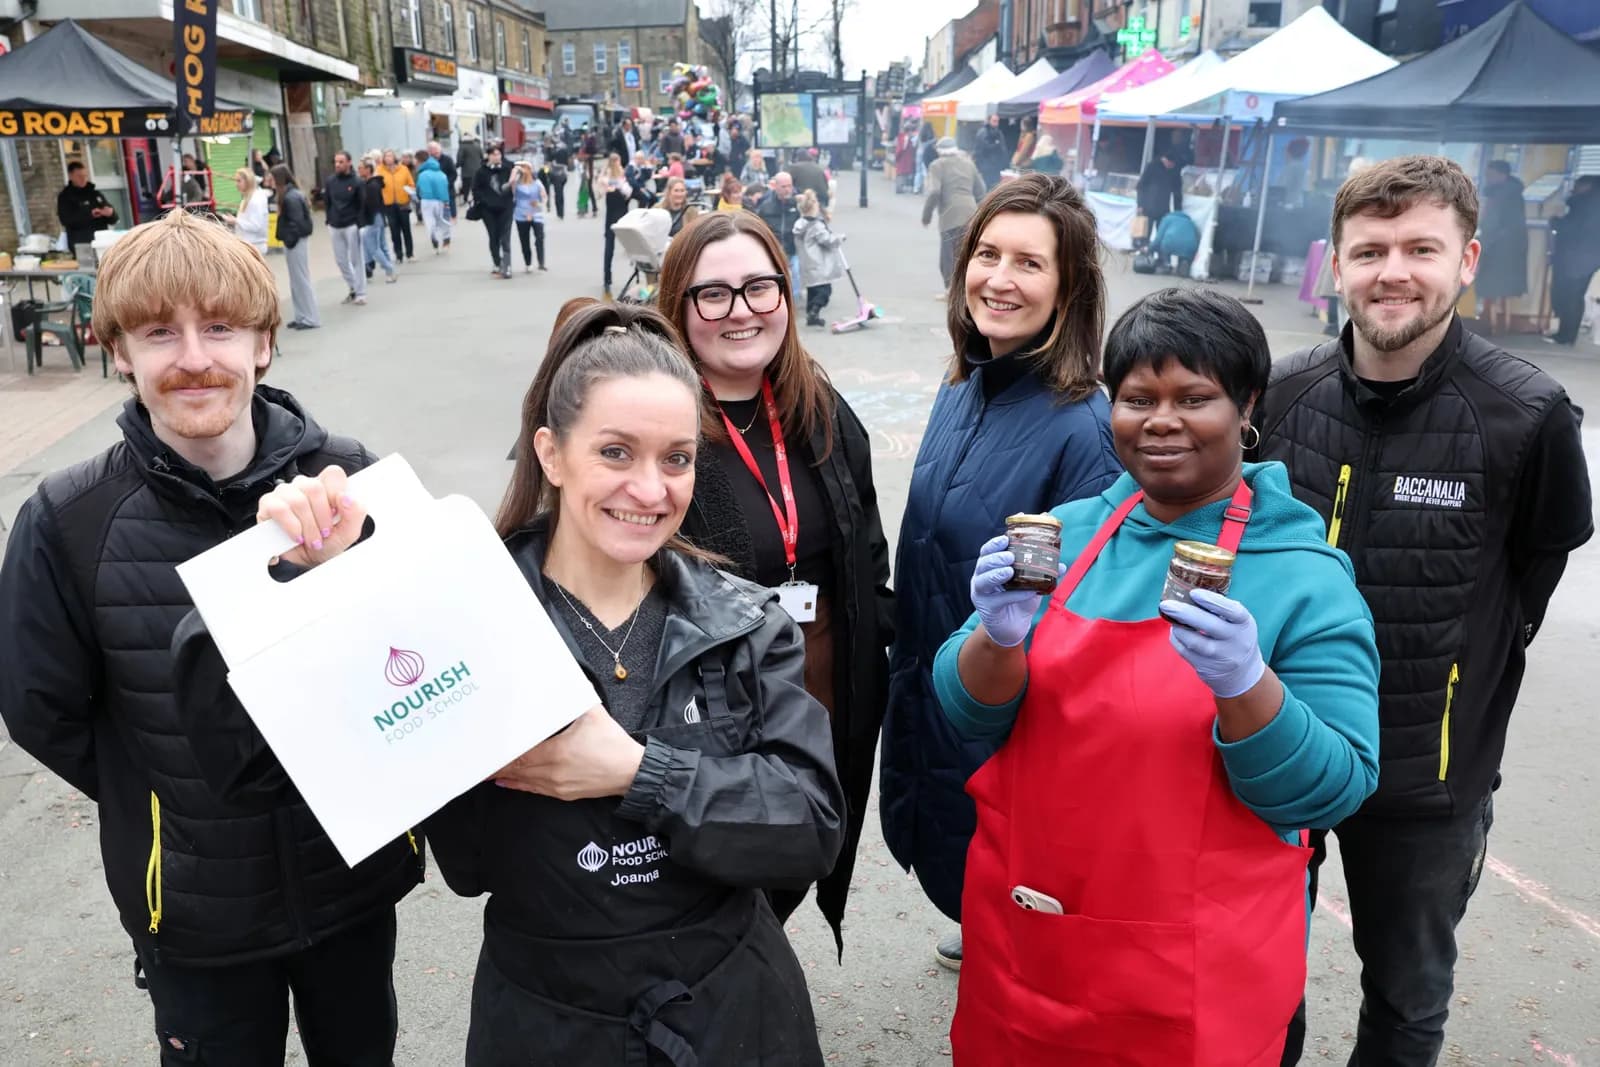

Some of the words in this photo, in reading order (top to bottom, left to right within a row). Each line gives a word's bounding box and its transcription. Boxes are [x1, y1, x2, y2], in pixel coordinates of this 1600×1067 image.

[184, 24, 206, 116] HOG
[23, 111, 124, 135] ROAST
[1393, 476, 1465, 500] BACCANALIA
[373, 661, 471, 731] NOURISH
[385, 716, 423, 744] FOOD
[426, 681, 480, 719] SCHOOL
[612, 836, 660, 857] NOUR
[612, 856, 643, 866] FOOD
[611, 869, 660, 886] Joanna
